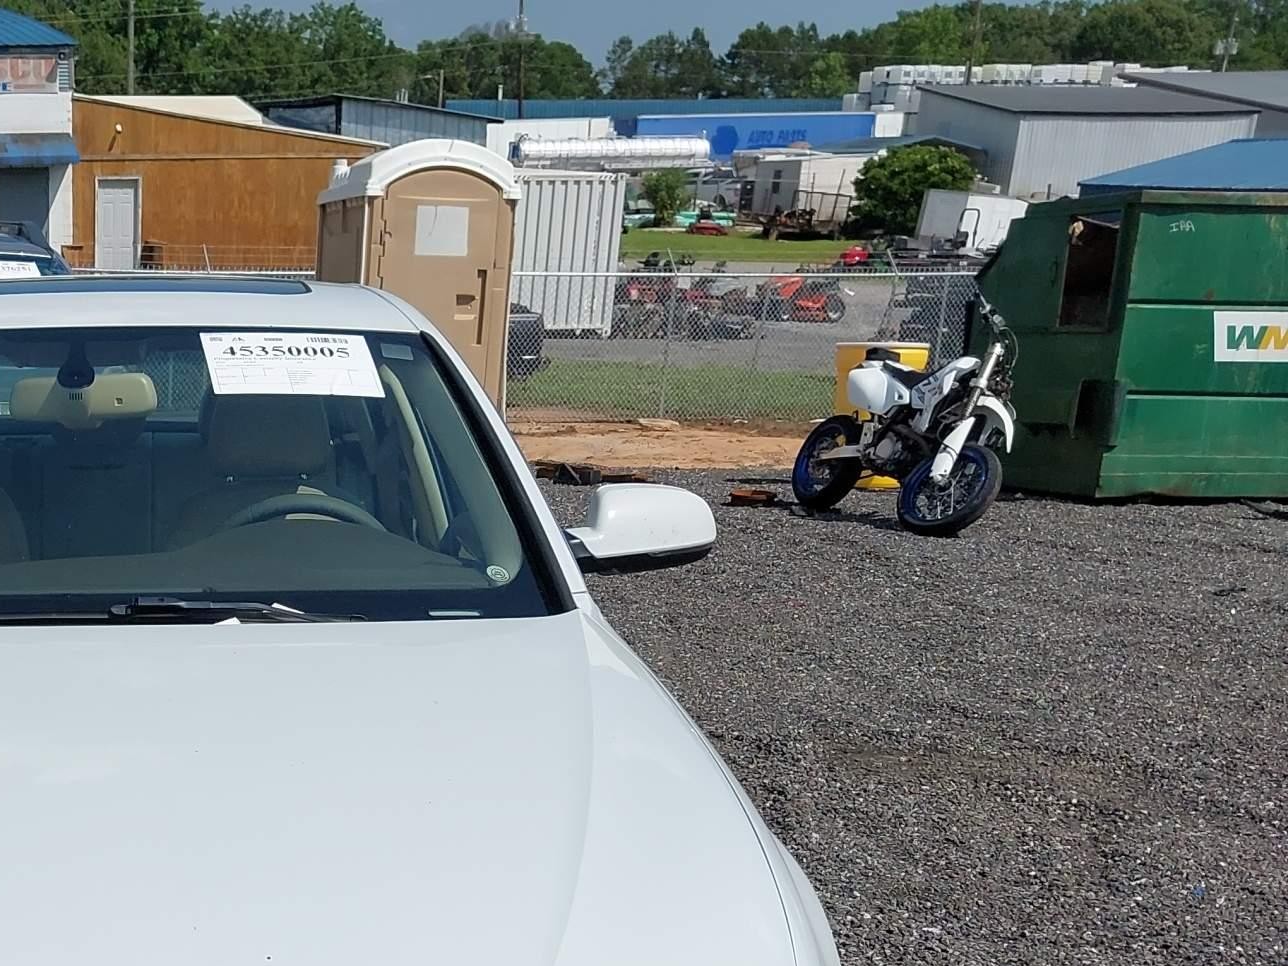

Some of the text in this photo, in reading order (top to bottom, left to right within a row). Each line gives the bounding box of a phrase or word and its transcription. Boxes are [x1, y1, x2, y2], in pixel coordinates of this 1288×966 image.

[747, 129, 808, 144] AUTO PARTS
[222, 345, 350, 358] 45350005
